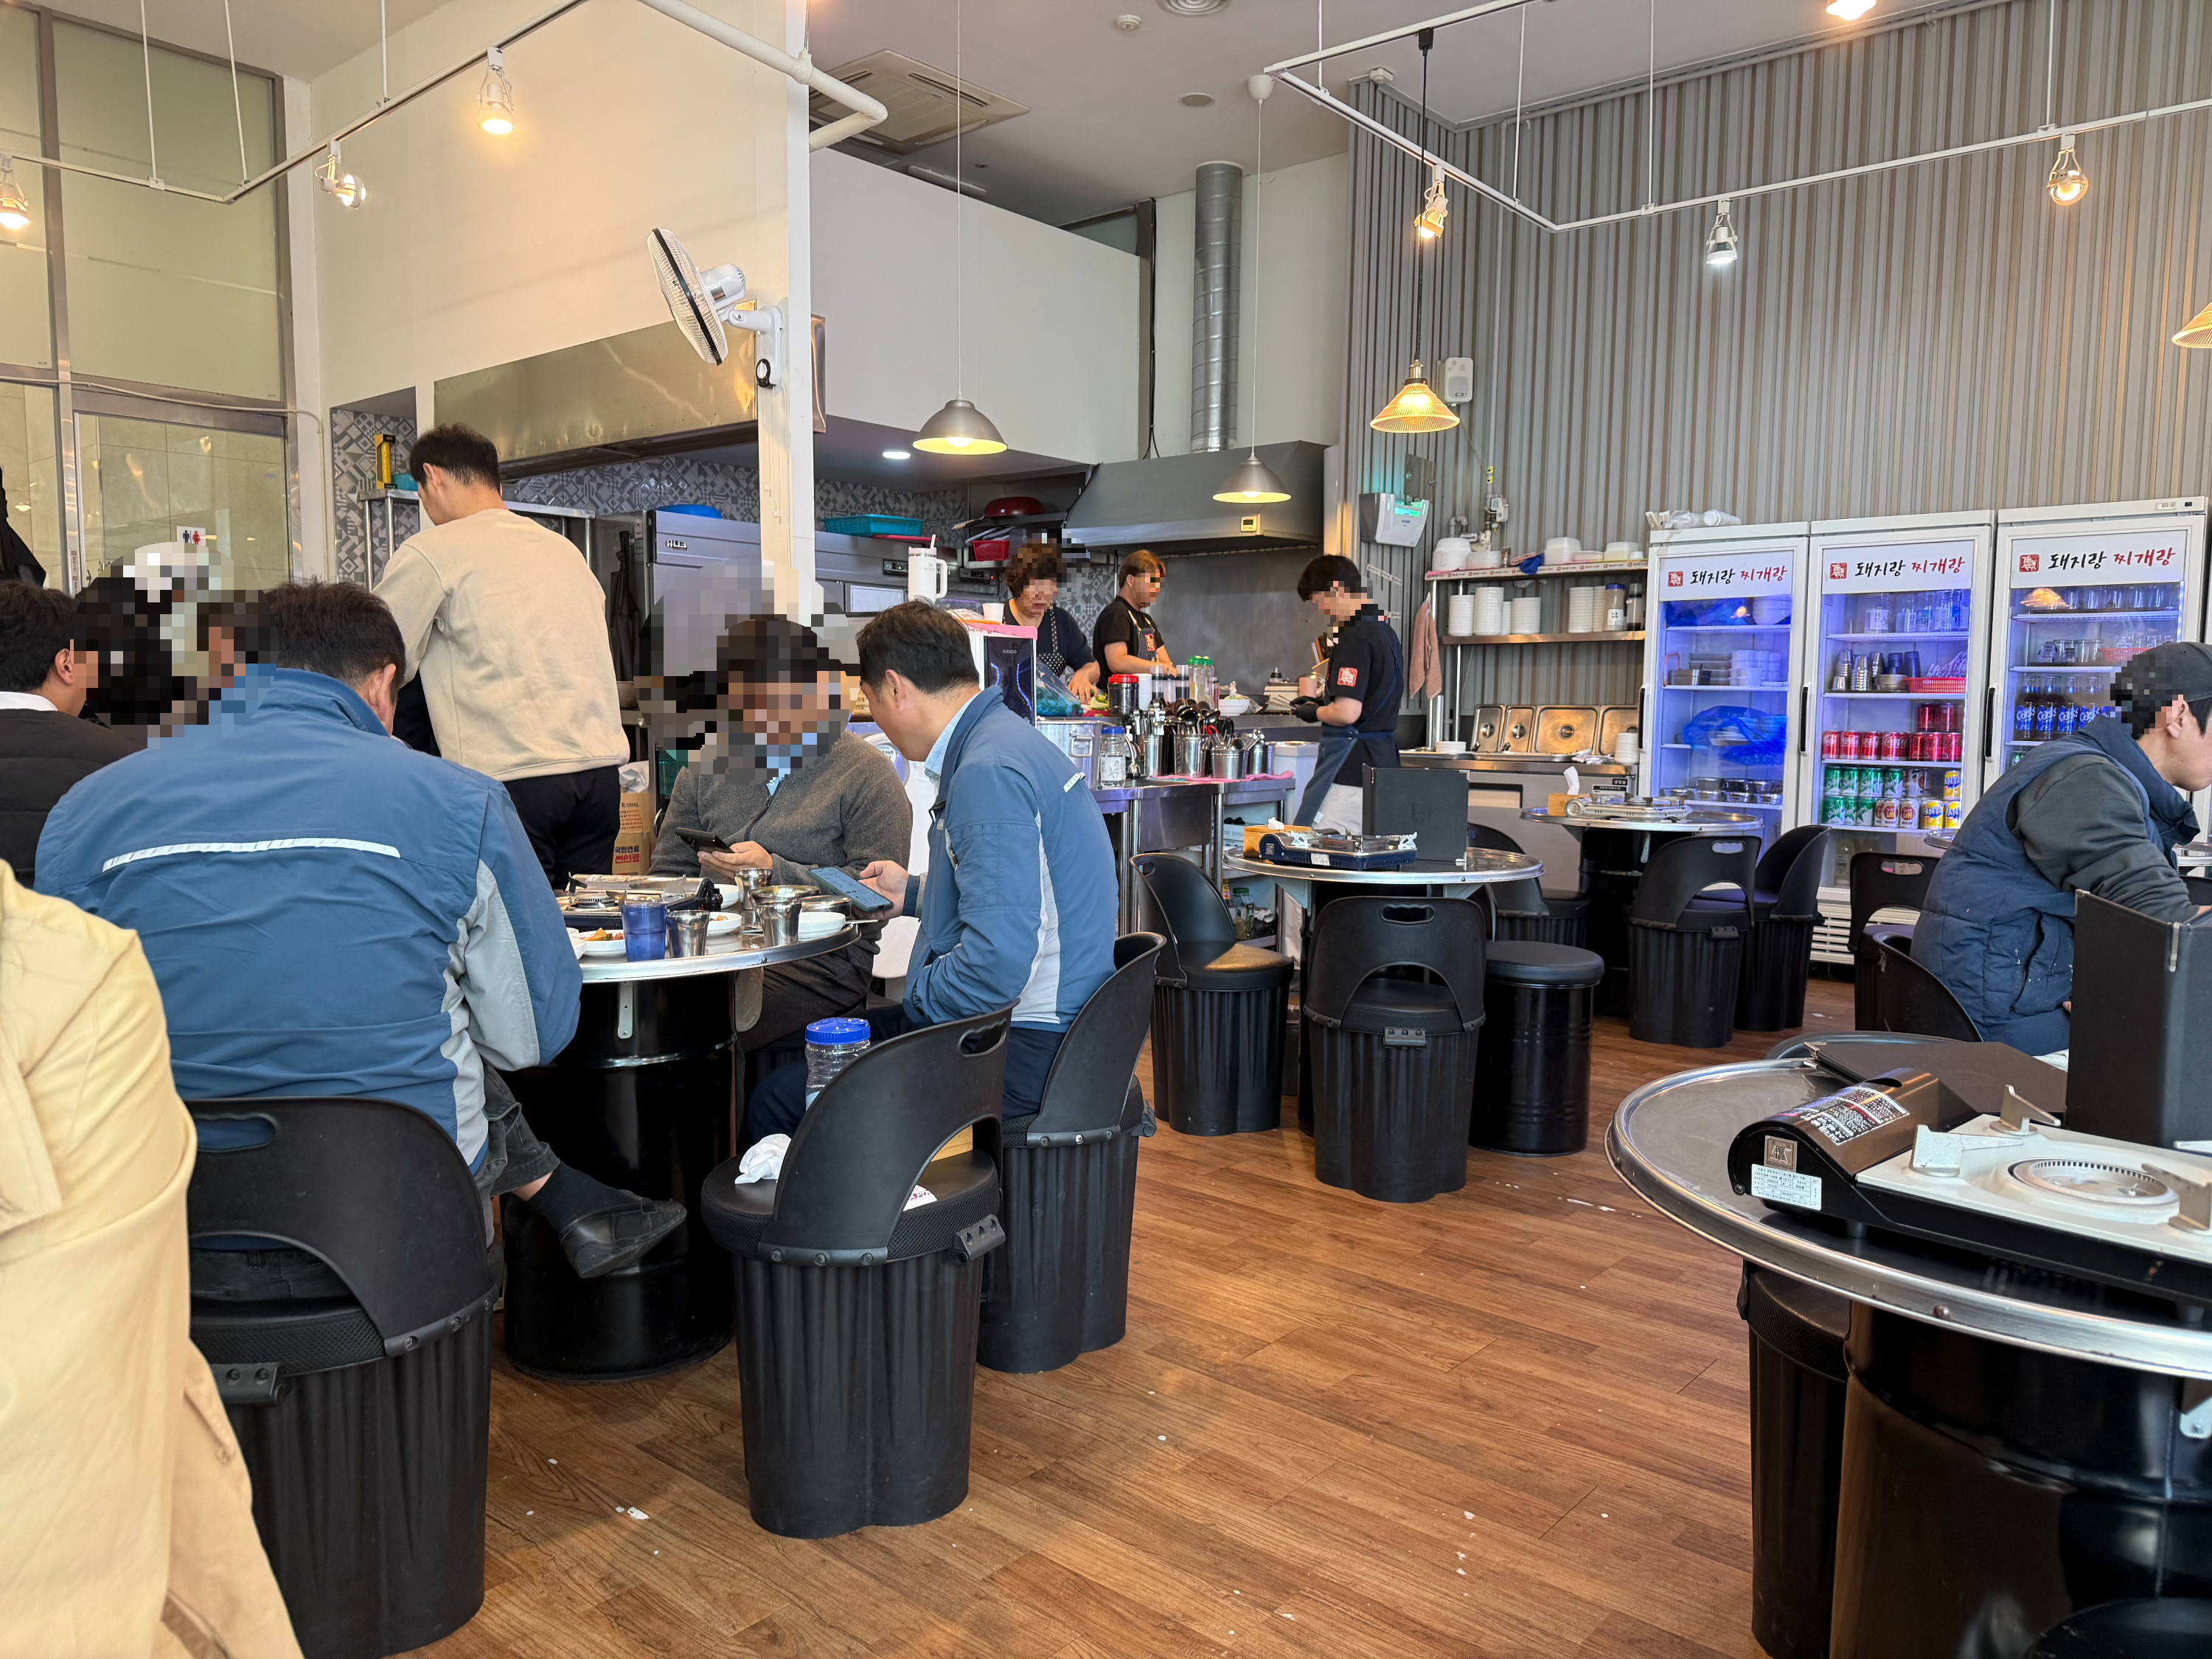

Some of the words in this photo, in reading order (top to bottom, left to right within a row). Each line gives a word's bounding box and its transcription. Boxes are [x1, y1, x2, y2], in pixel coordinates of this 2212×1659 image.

[1854, 560, 1906, 577] 돼지랑
[1911, 557, 1965, 574] 찌개랑
[2048, 551, 2107, 570] 돼지랑
[2113, 547, 2176, 567] 찌개랑
[1690, 568, 1736, 585] 돼지랑
[1740, 566, 1787, 582] 찌개랑
